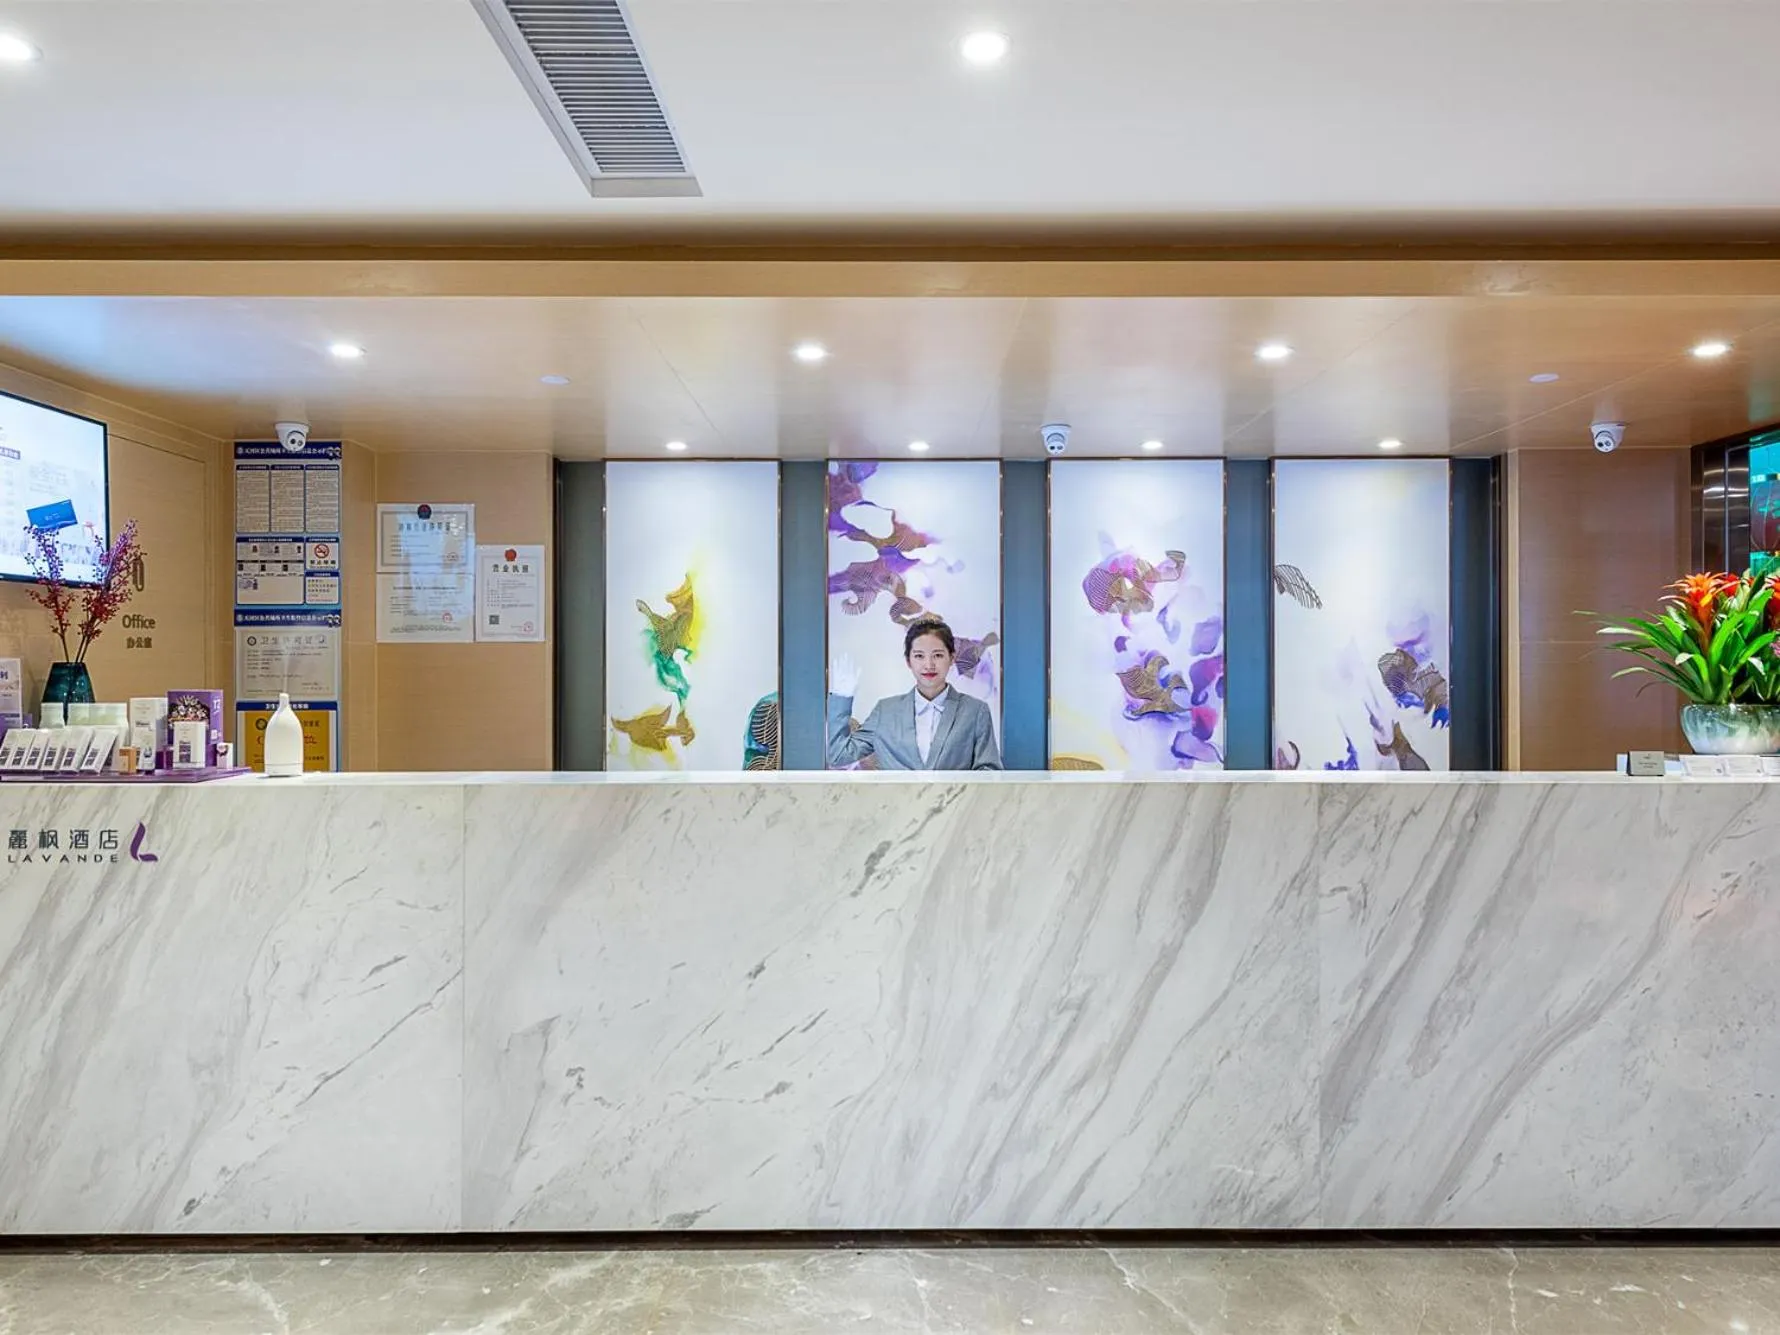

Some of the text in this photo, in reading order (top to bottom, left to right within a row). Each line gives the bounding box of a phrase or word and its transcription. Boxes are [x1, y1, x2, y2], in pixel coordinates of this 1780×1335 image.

[122, 614, 156, 629] Office
[126, 636, 152, 649] 办公室
[8, 829, 118, 850] 麗枫酒店
[8, 854, 119, 863] LAVANDE
